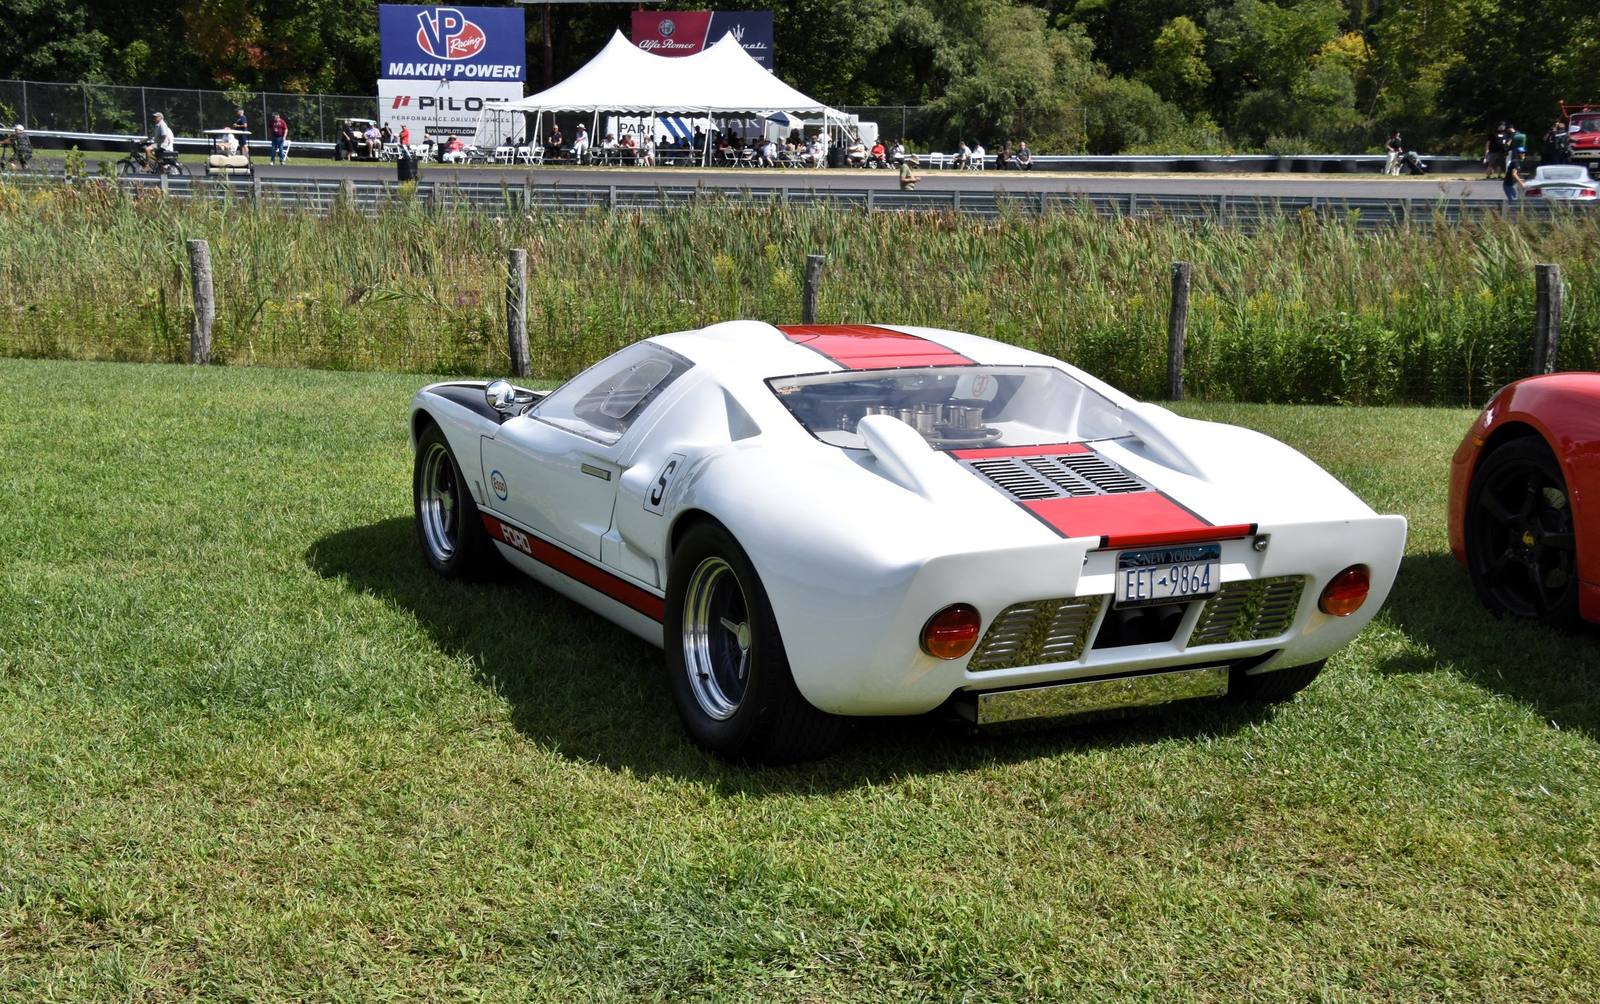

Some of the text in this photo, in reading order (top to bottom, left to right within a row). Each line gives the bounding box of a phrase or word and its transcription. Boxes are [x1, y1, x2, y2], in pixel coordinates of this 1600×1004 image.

[417, 8, 465, 58] VP
[450, 36, 482, 54] Racing
[639, 38, 696, 52] Alfa Romeo
[453, 63, 521, 78] POWER!
[500, 522, 532, 554] FORD
[1143, 549, 1195, 564] NEW YORK
[1126, 561, 1210, 600] EET 9864
